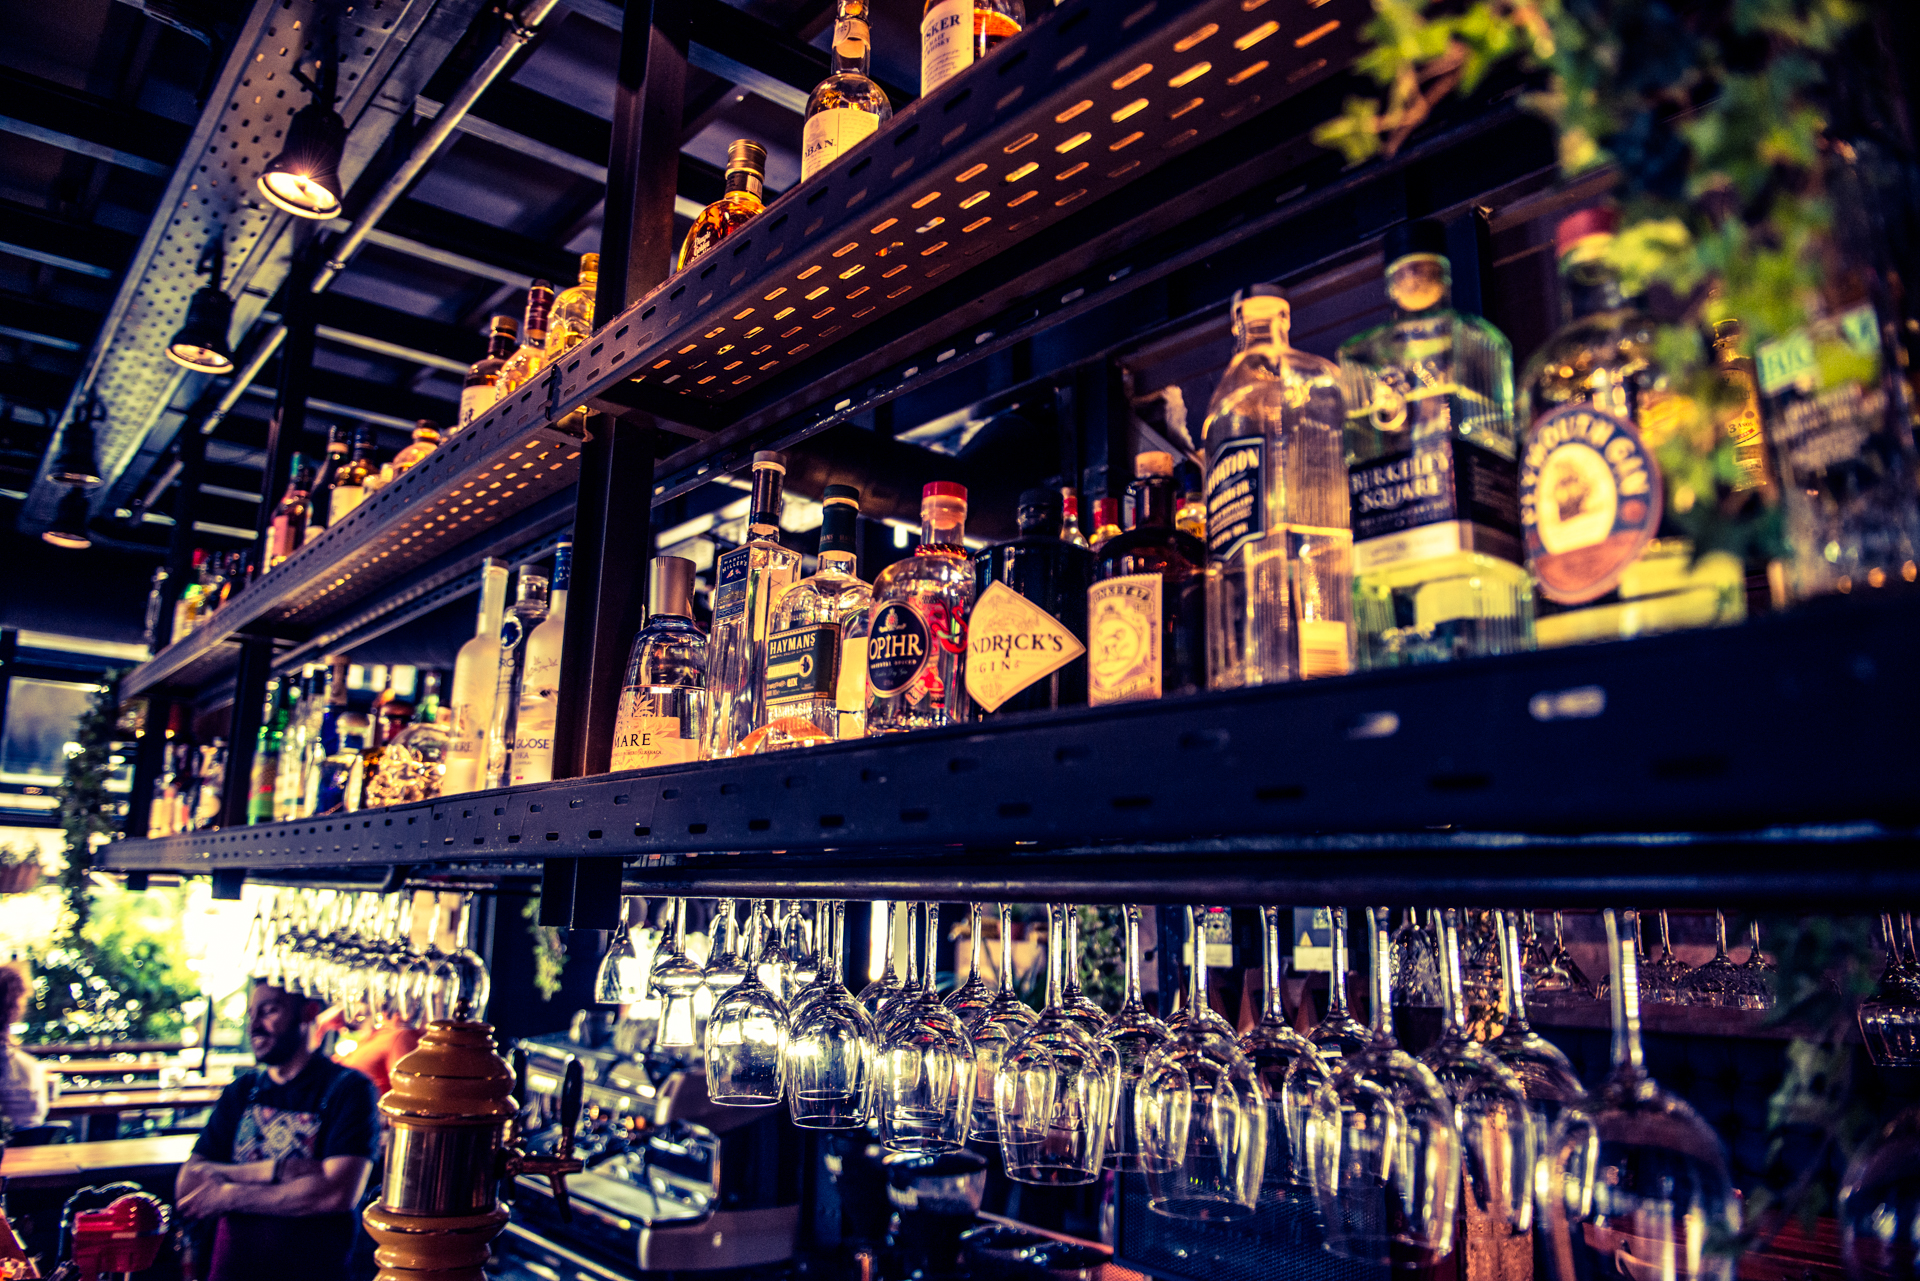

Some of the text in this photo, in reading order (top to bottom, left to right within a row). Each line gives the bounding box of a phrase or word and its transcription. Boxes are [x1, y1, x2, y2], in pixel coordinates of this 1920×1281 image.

[1604, 436, 1650, 497] GIN
[1358, 473, 1440, 513] SQUARE
[724, 554, 747, 565] MARTIN
[869, 633, 924, 660] OPIHR
[980, 661, 1010, 673] GIN
[516, 738, 550, 750] GOOSE
